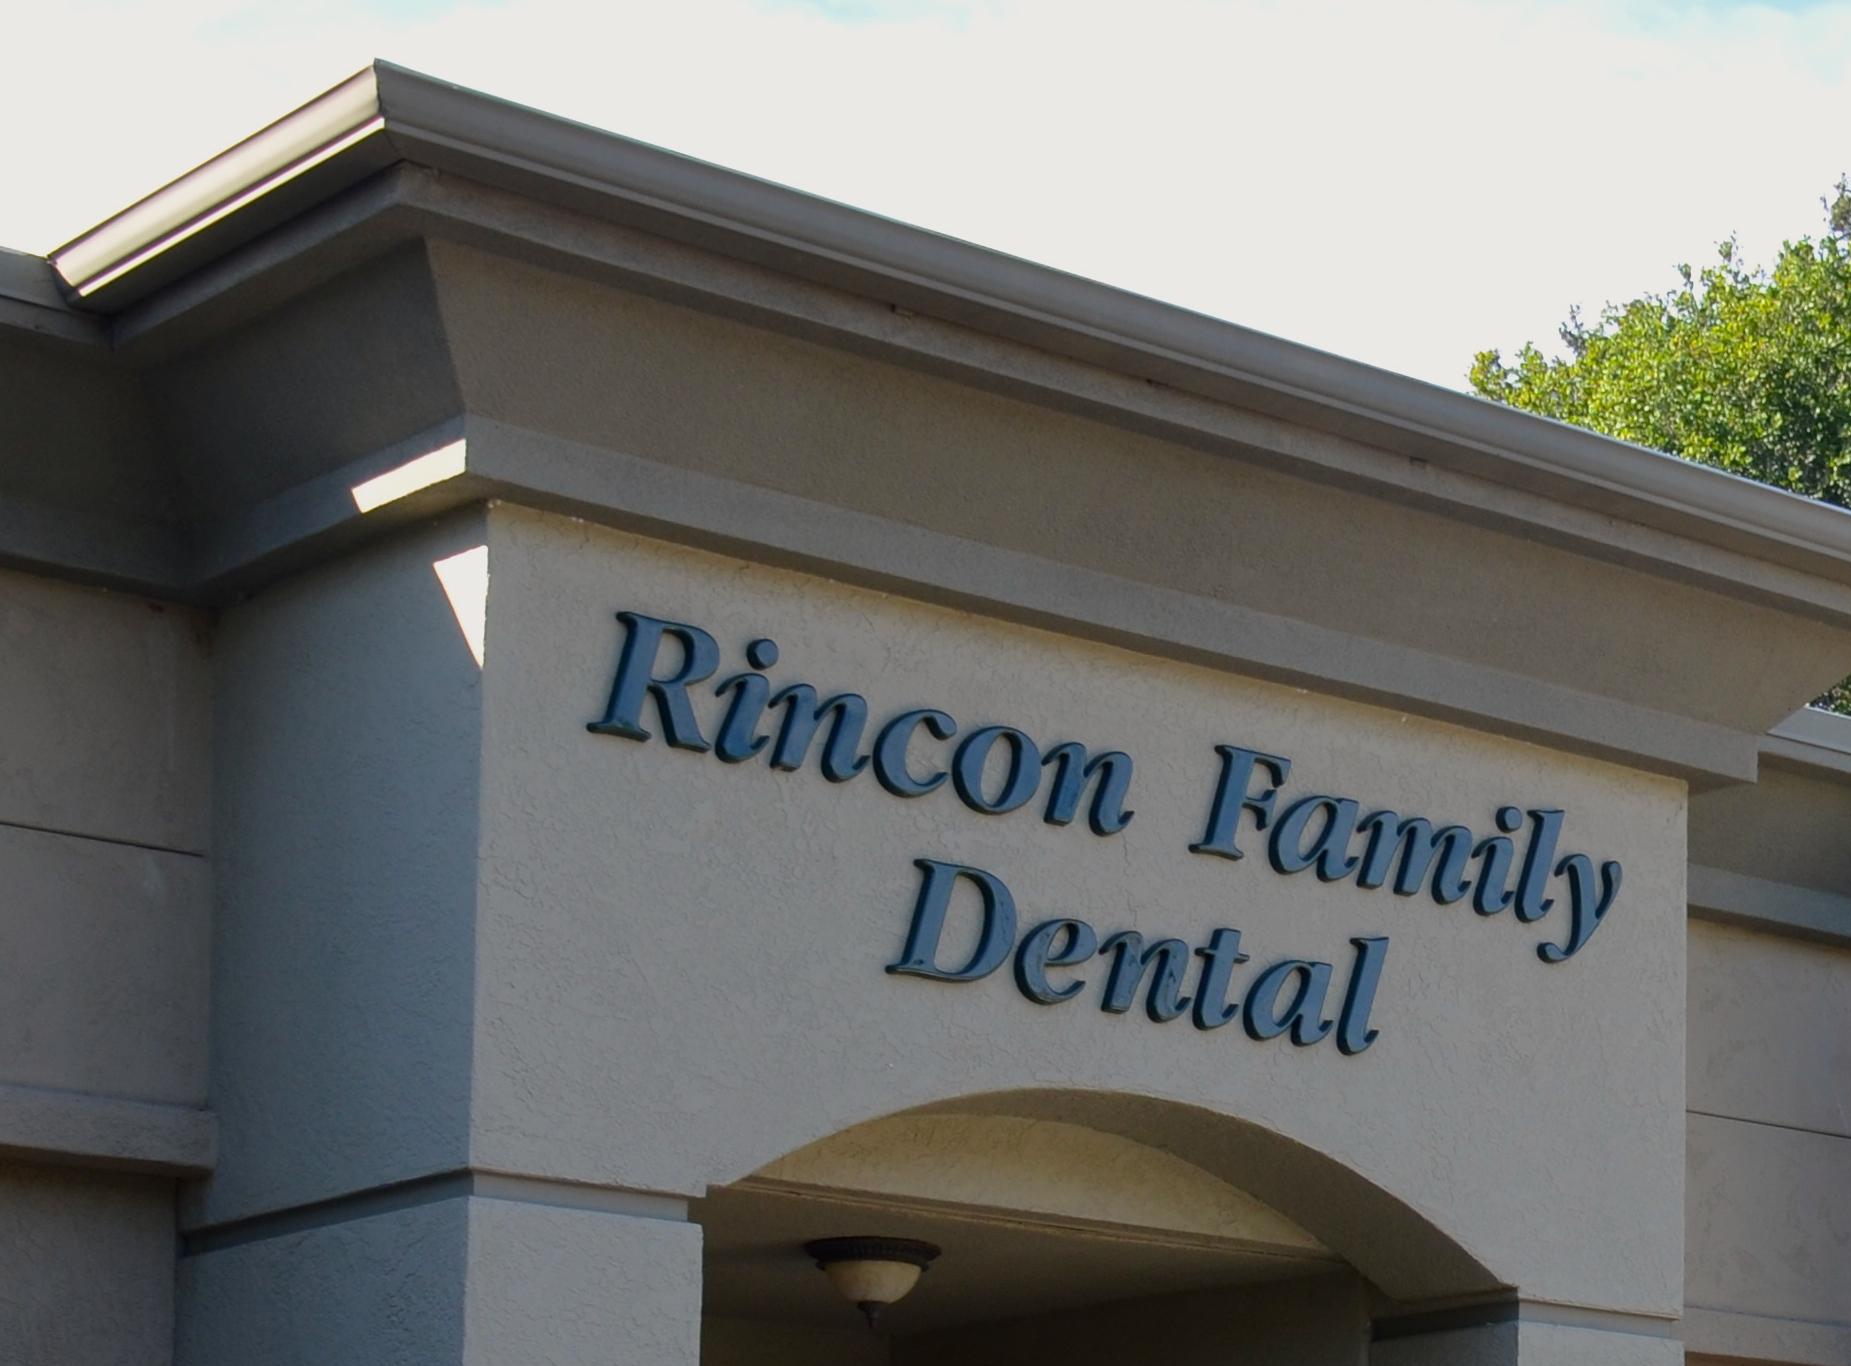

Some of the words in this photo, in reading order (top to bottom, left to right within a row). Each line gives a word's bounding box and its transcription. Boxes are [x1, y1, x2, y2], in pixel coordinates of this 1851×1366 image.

[587, 611, 1135, 836] Rincon
[1189, 745, 1621, 963] Family
[886, 859, 1389, 1055] Dental
